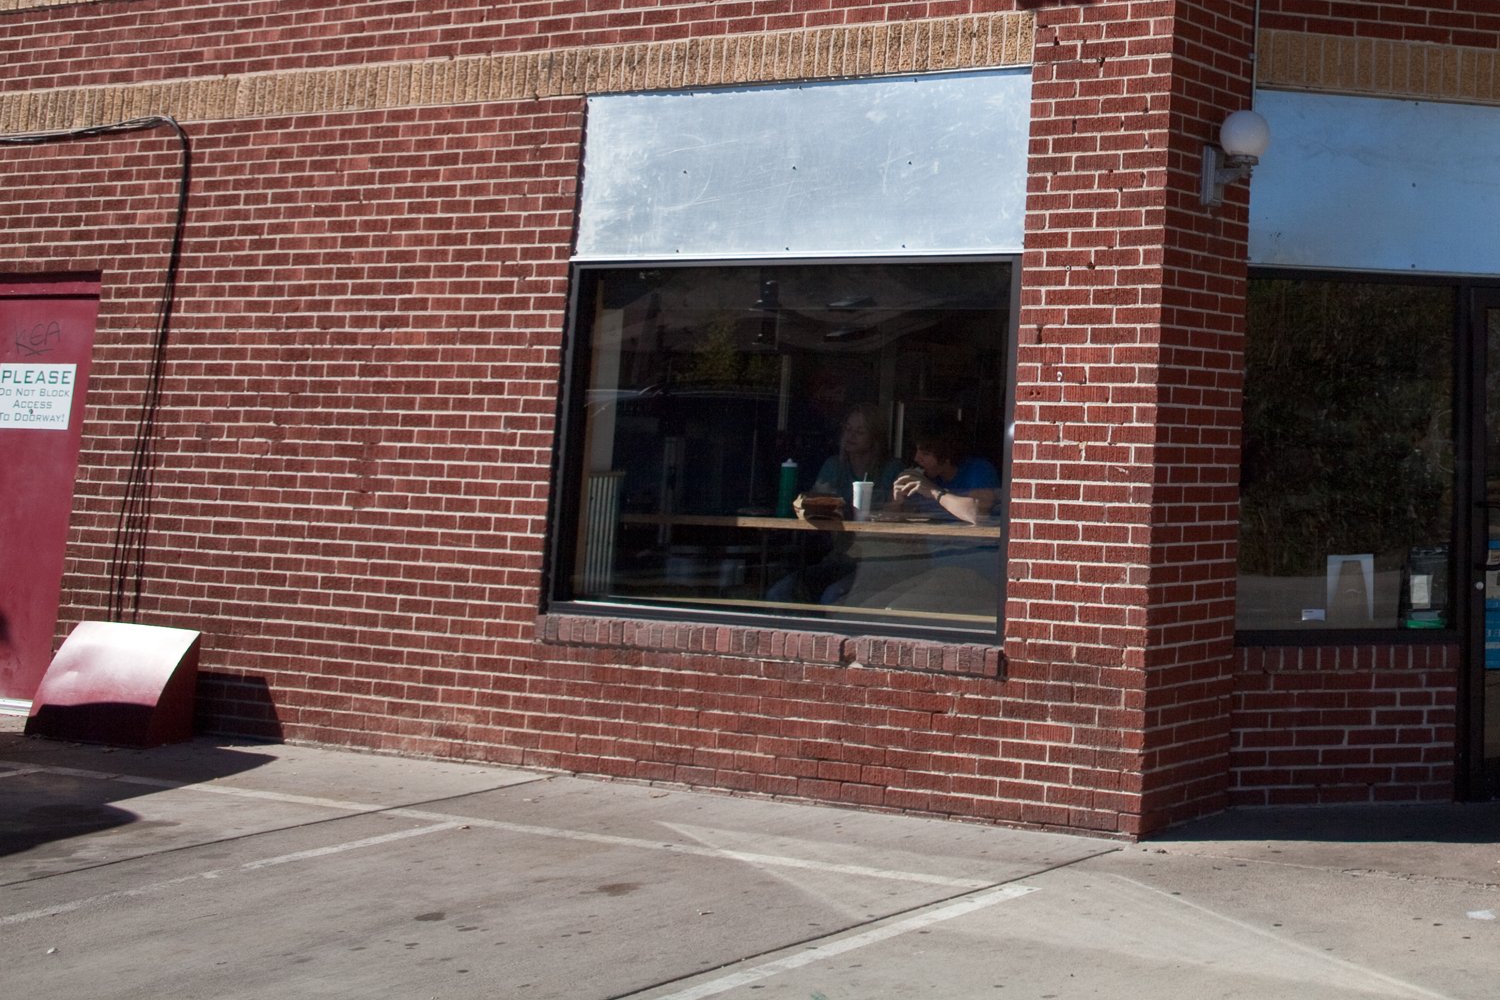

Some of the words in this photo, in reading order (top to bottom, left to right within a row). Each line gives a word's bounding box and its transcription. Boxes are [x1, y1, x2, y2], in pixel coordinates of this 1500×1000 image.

[1, 370, 72, 385] PLEASE
[16, 388, 35, 397] NOT
[40, 388, 70, 398] BLOCK
[13, 399, 52, 409] ACCESS
[14, 412, 65, 423] DOORWAY!
